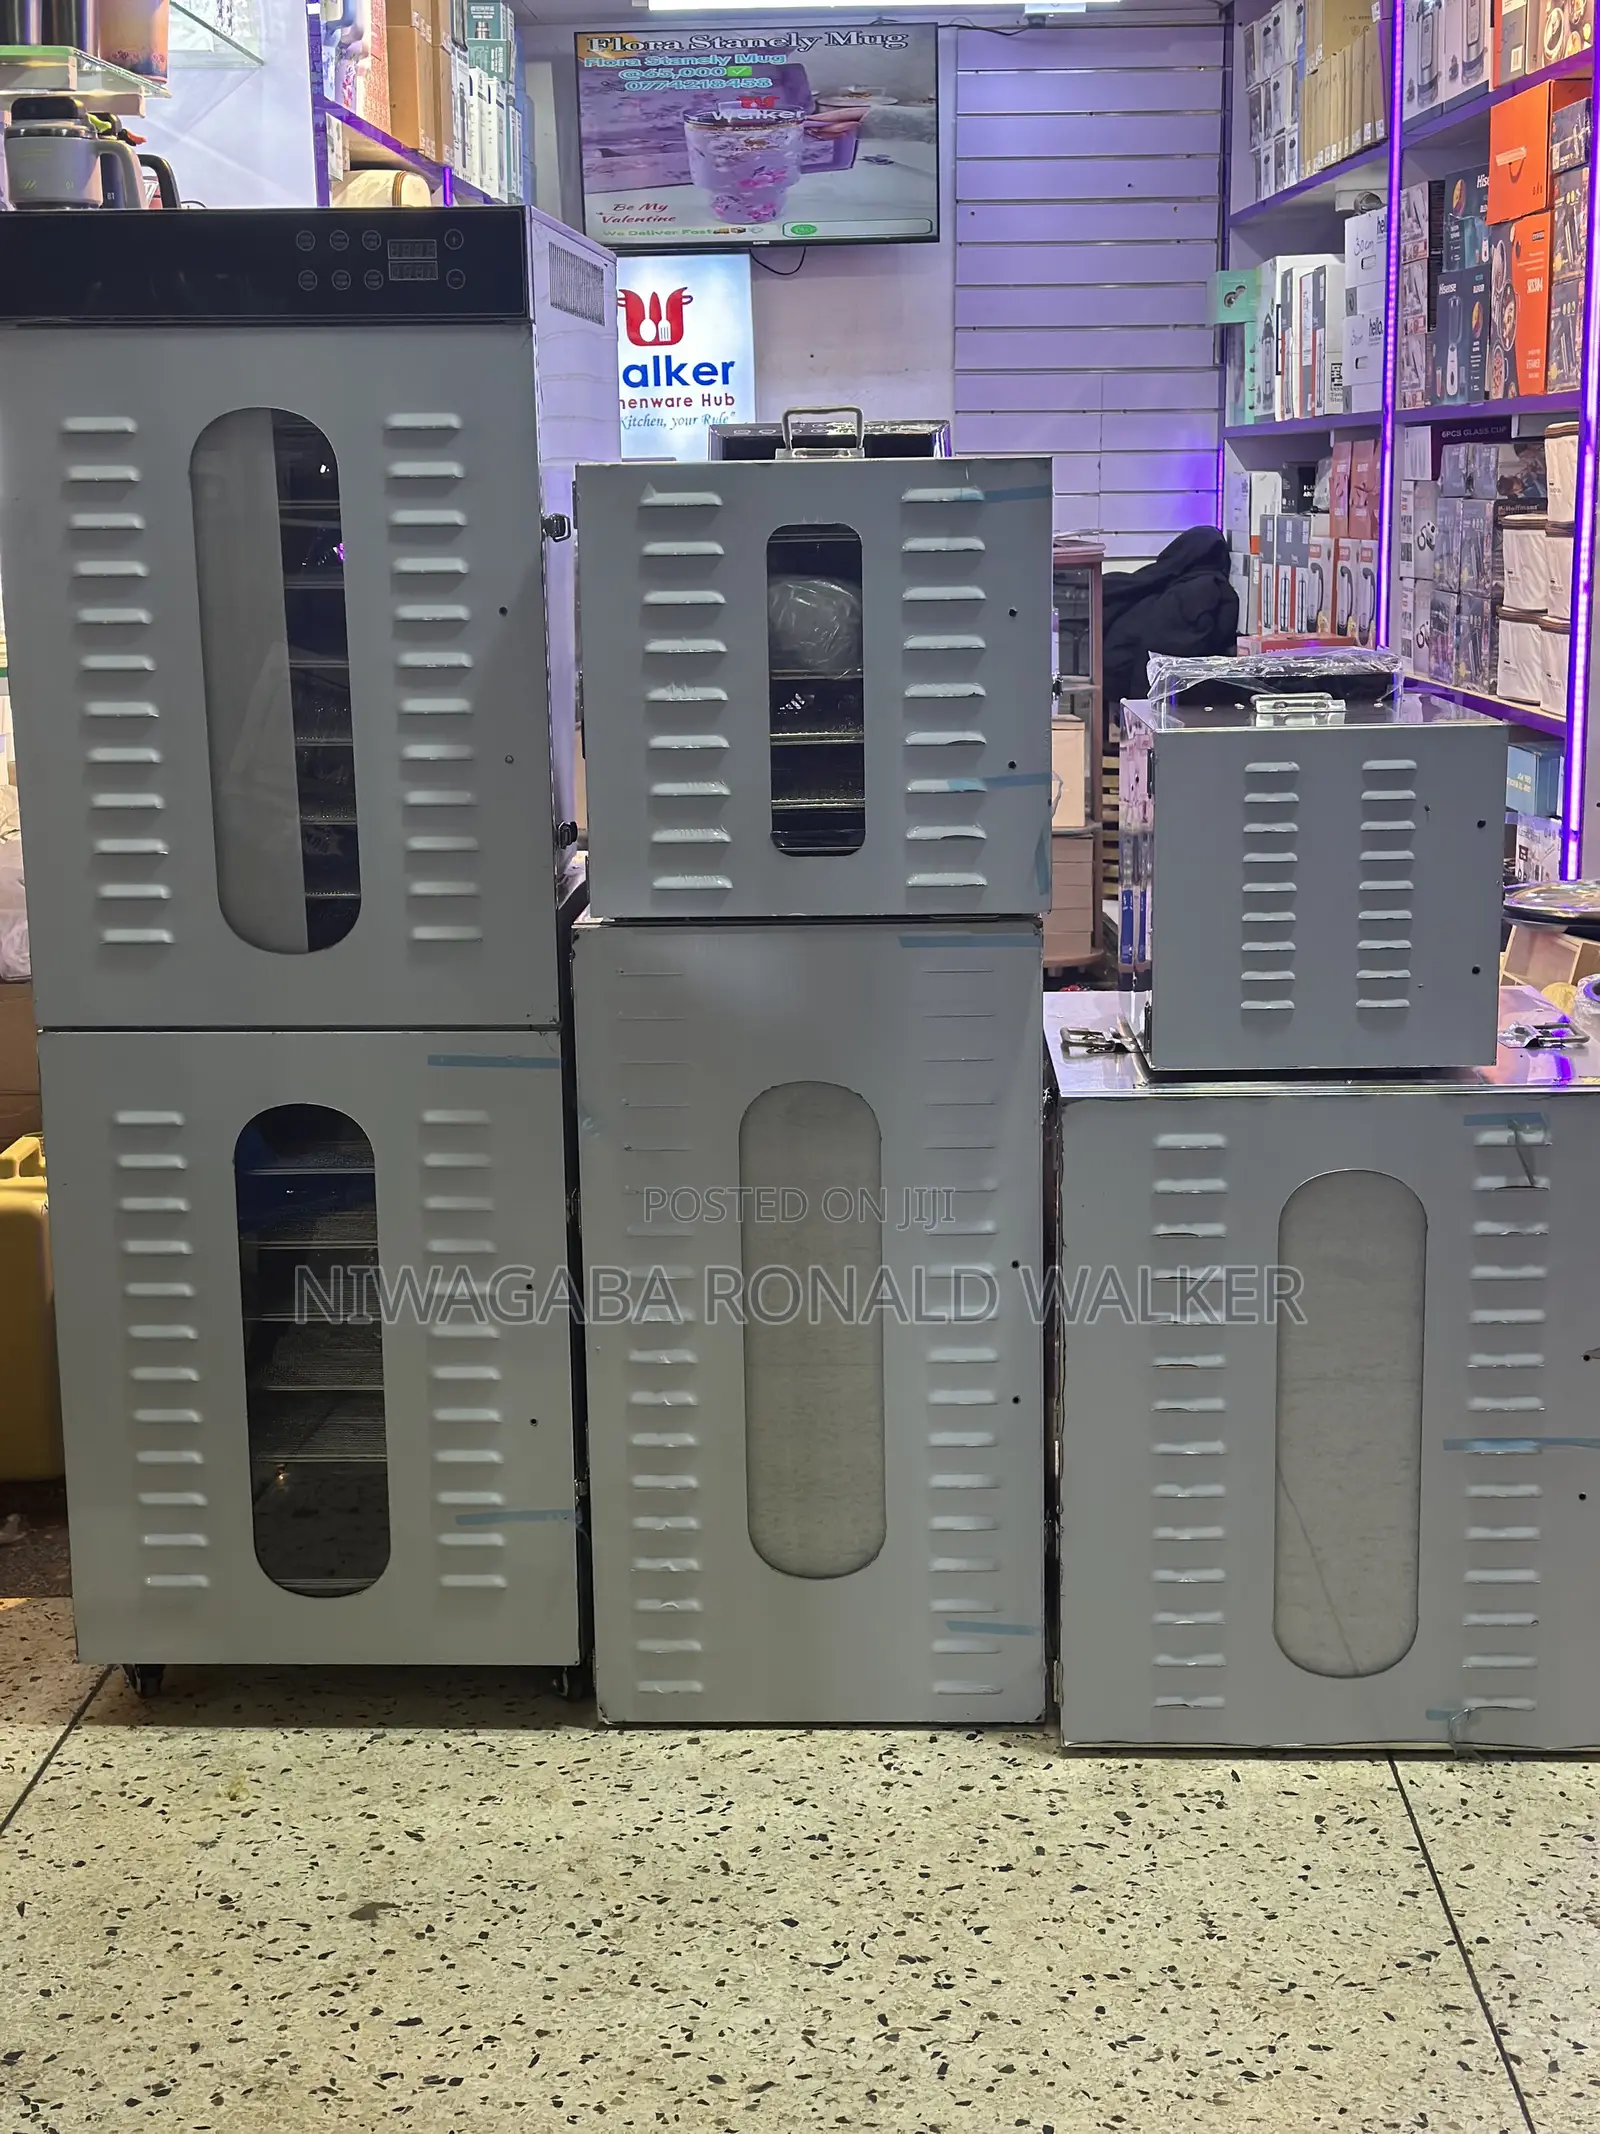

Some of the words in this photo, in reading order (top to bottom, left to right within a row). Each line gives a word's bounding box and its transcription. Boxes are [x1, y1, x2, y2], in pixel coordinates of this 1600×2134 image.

[587, 35, 683, 52] Flora
[690, 32, 822, 52] Stanely
[824, 30, 909, 50] Mug
[584, 55, 641, 67] Flora
[644, 53, 731, 66] Stanely
[735, 53, 787, 65] Mug
[618, 66, 727, 81] @65,000
[613, 203, 634, 212] Be
[639, 202, 669, 213] My
[602, 215, 677, 224] Valentine
[701, 393, 735, 406] Hub
[669, 417, 698, 430] your
[1463, 428, 1489, 436] GLASS
